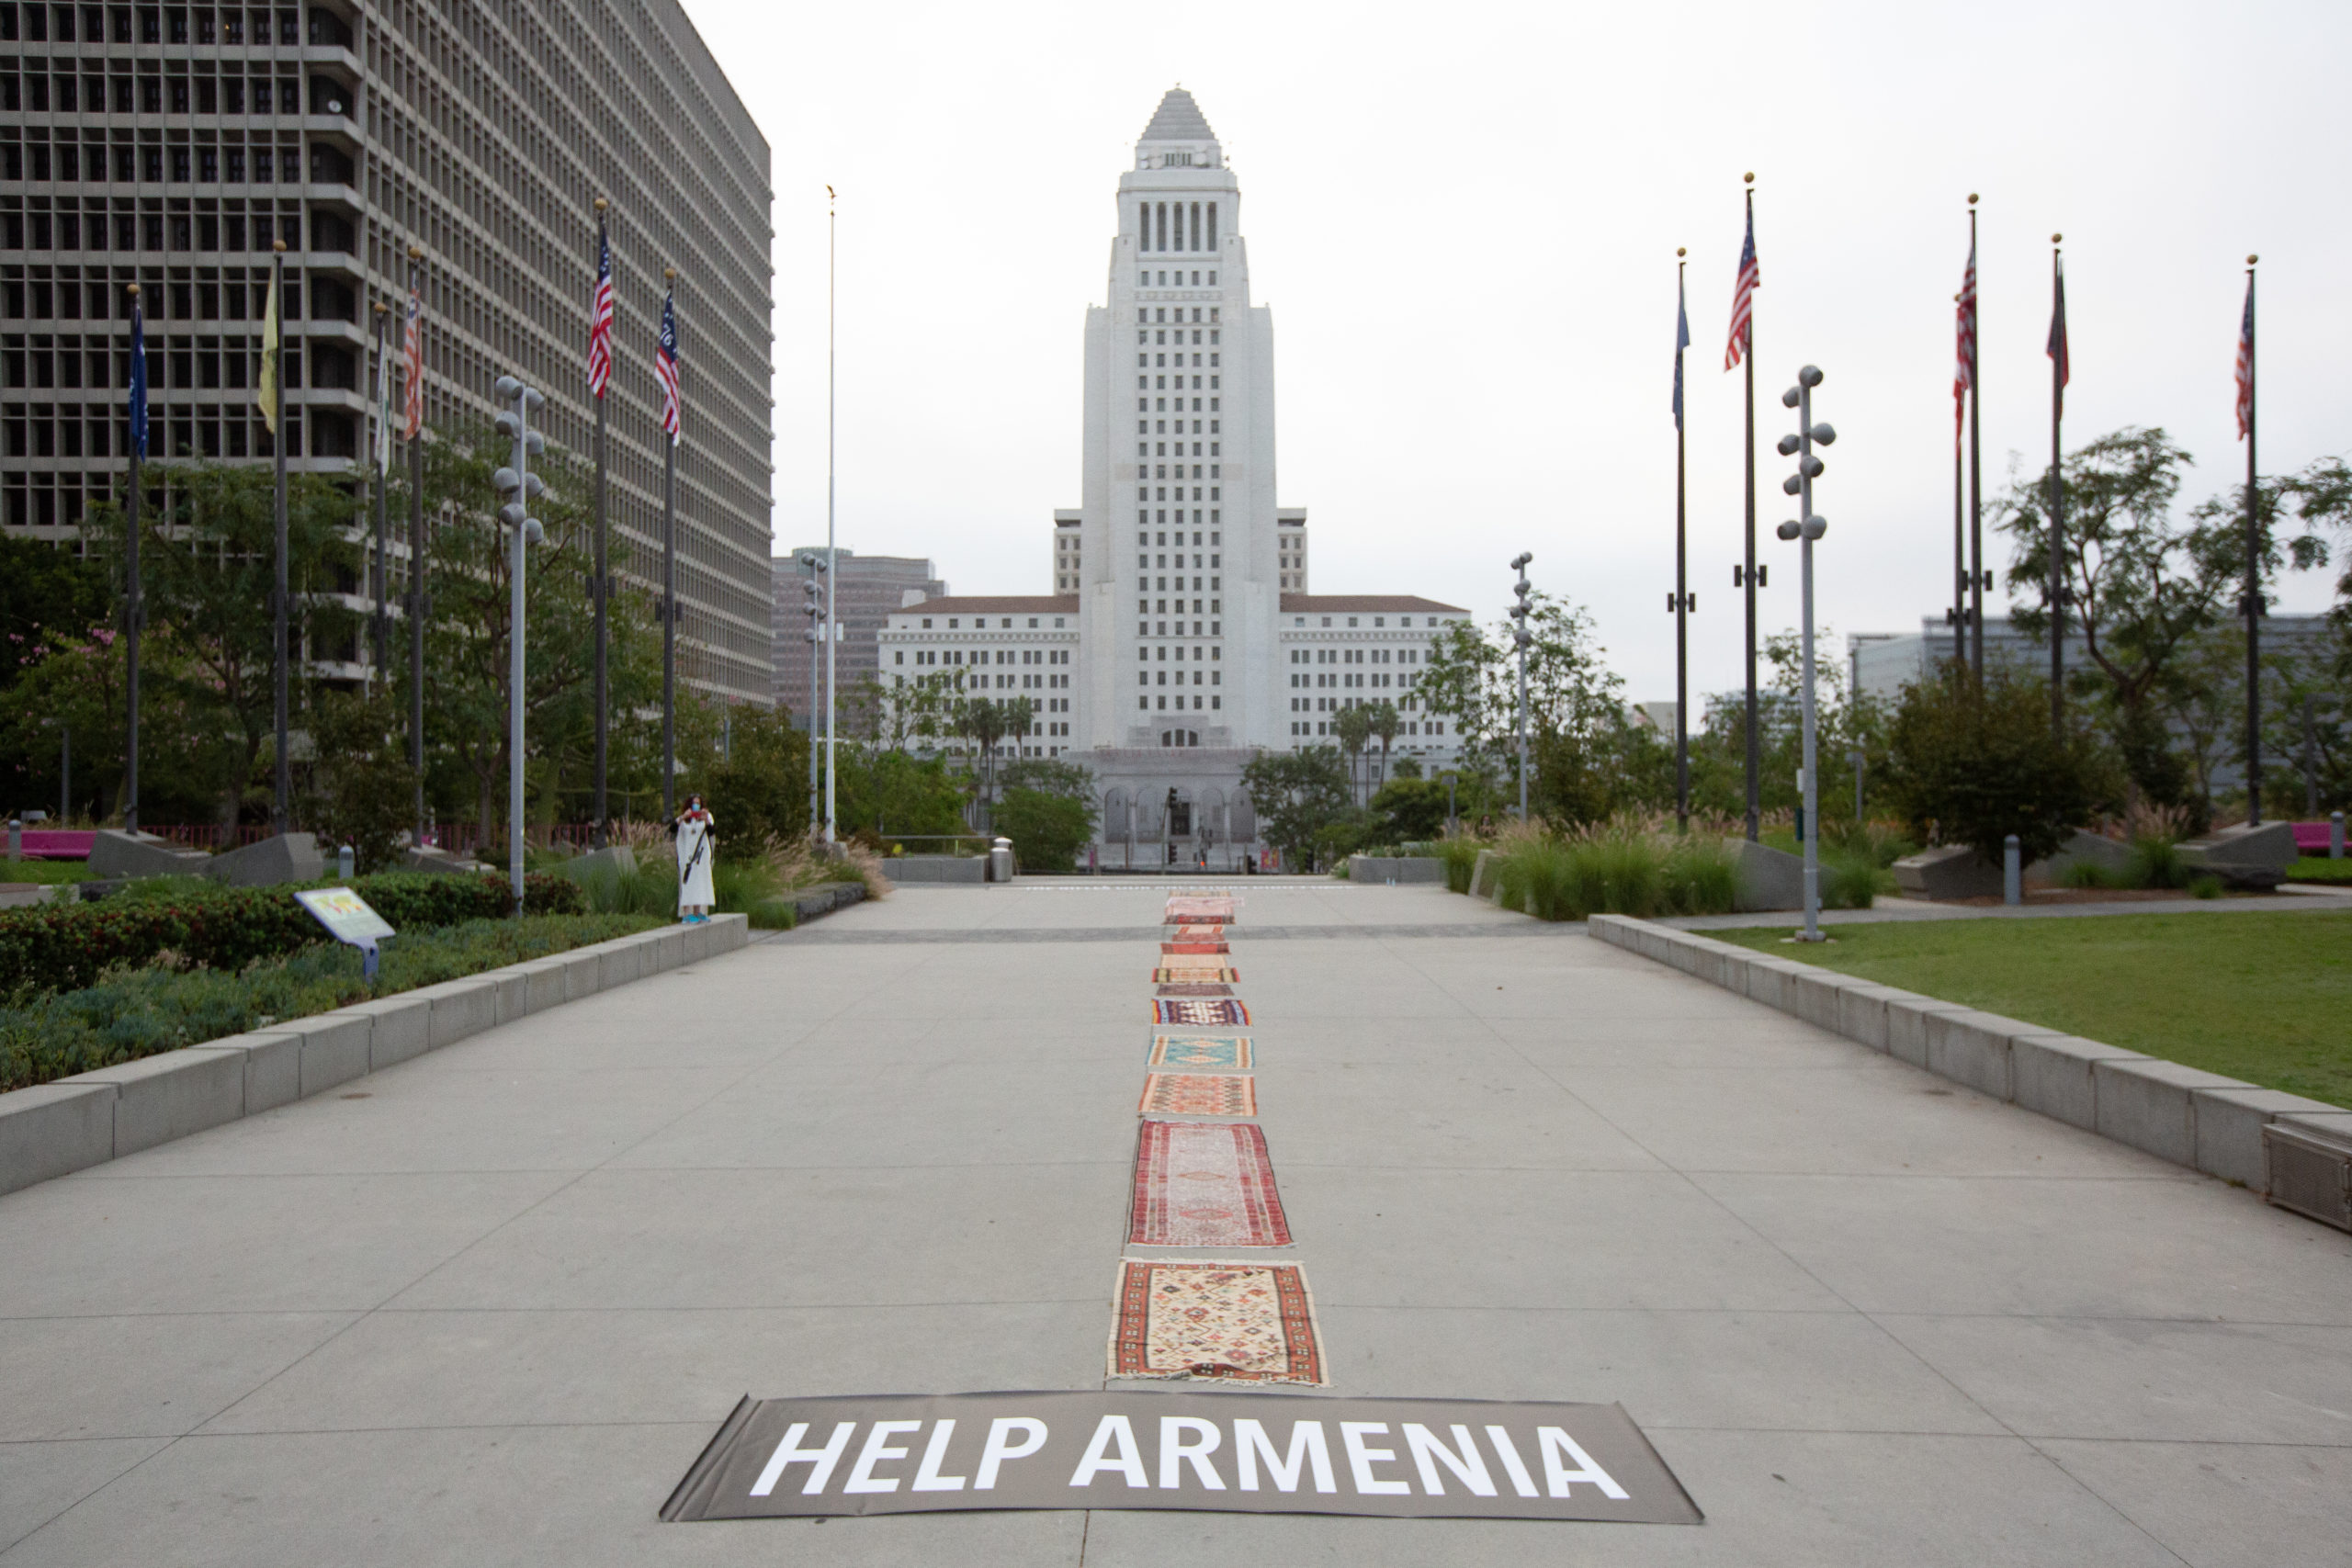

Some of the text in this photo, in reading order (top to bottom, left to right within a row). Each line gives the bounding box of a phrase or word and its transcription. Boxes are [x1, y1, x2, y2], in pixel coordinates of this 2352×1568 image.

[660, 323, 674, 346] 76
[750, 1415, 1631, 1499] HELP ARMENIA
